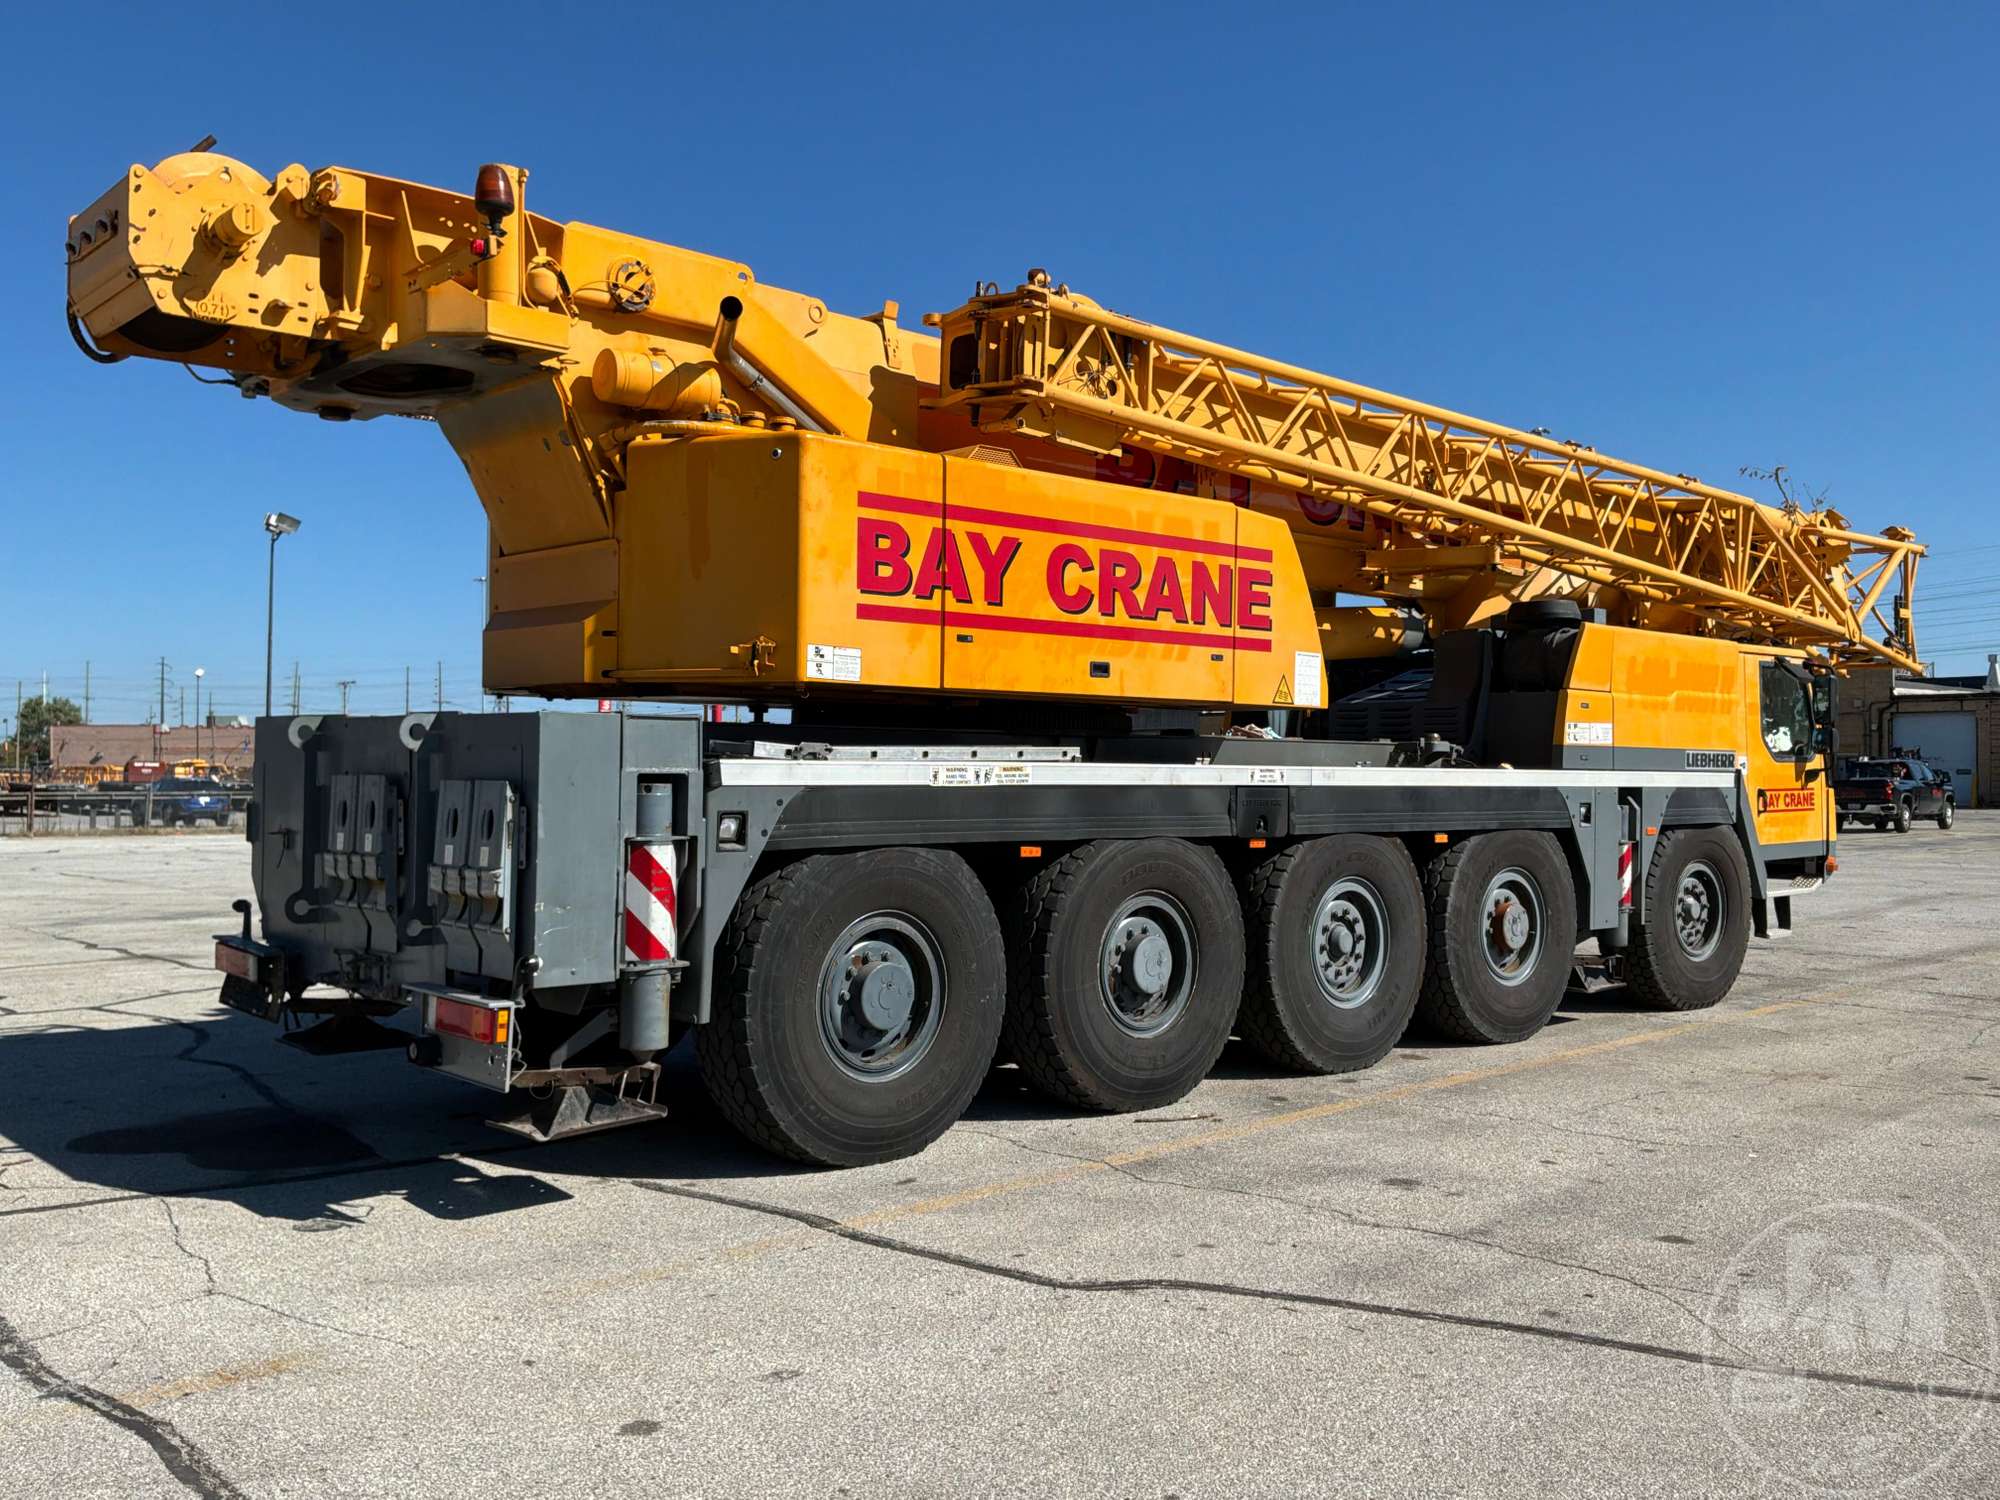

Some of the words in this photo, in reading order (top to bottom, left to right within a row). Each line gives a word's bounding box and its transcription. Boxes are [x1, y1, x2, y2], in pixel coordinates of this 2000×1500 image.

[857, 516, 1022, 606] BAY
[1046, 543, 1273, 632] CRANE
[1686, 751, 1736, 768] LIEBHERR
[1759, 792, 1780, 809] AY
[1783, 791, 1815, 808] CRANE
